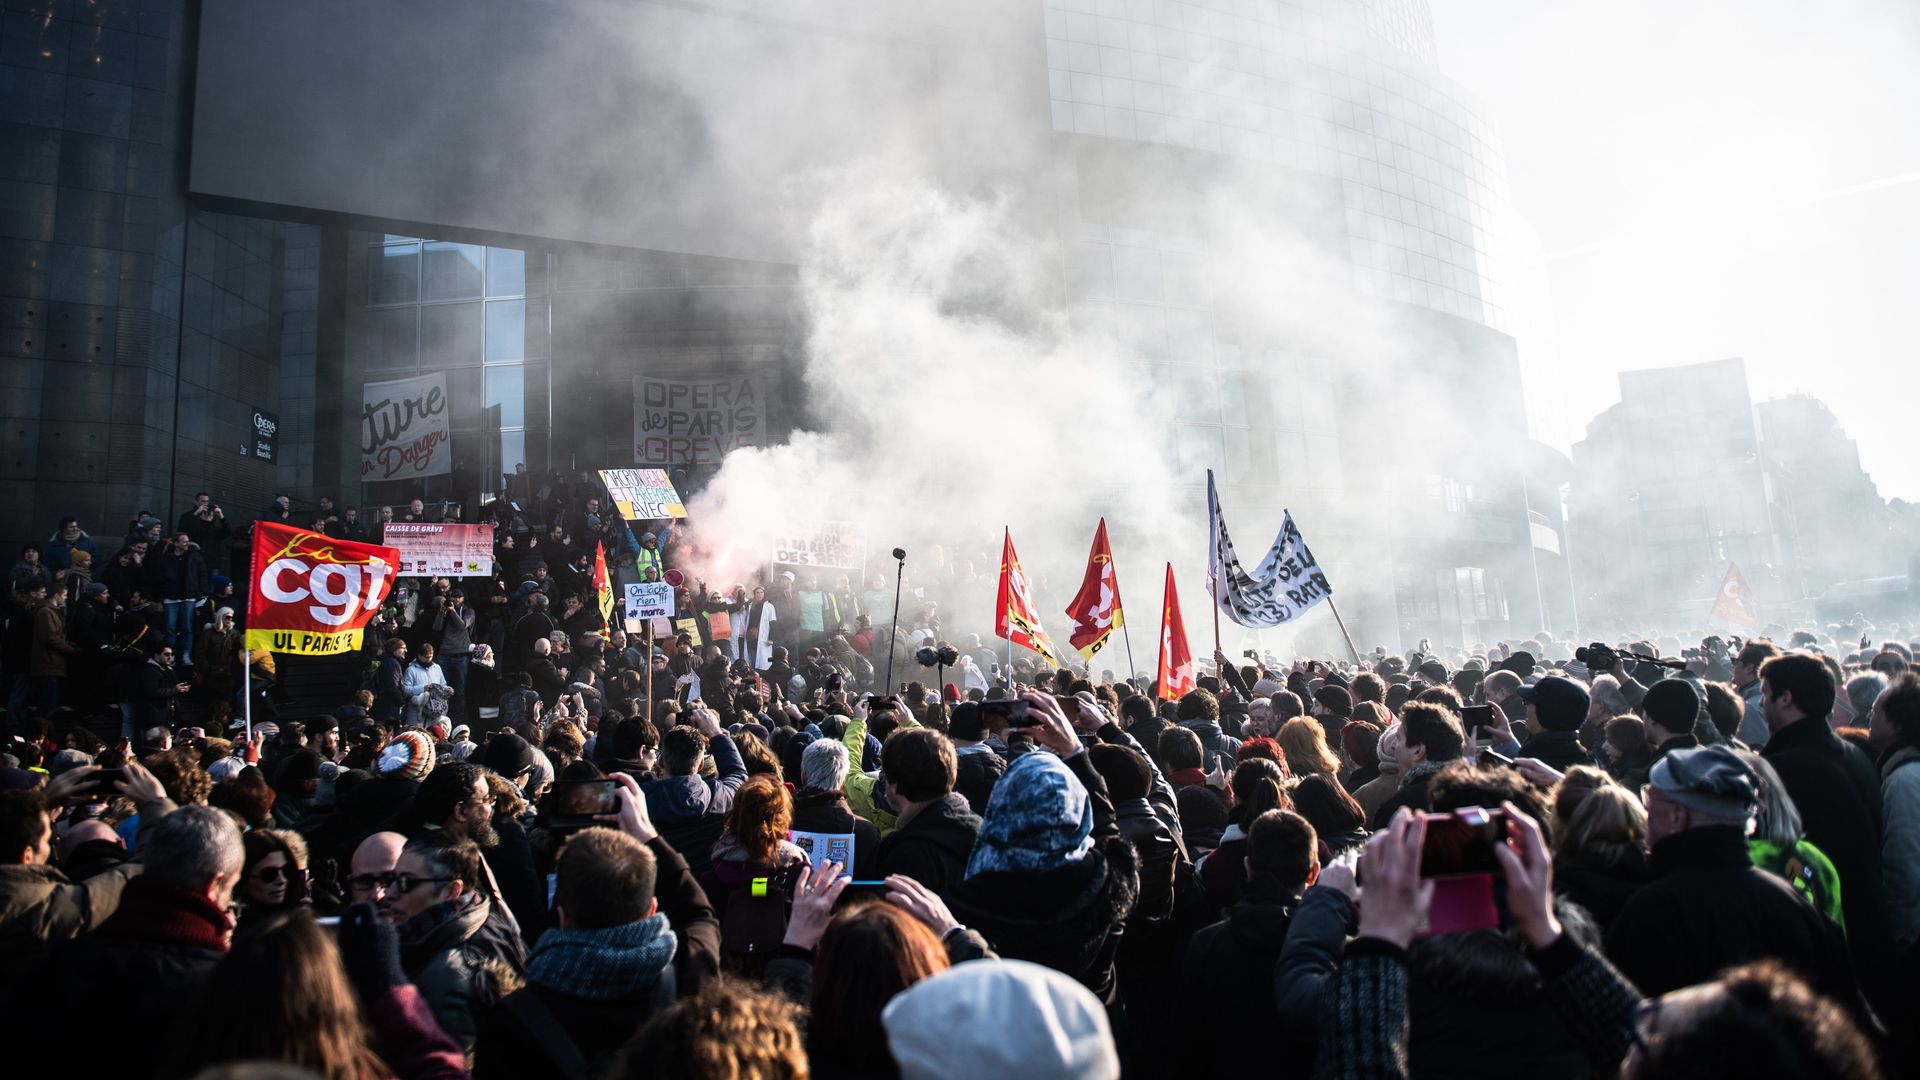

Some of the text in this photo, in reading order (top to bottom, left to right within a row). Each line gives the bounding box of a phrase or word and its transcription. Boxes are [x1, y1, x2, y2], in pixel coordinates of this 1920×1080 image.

[645, 380, 755, 409] OPERA
[641, 406, 757, 436] de PARIS
[377, 430, 449, 479] Danger
[609, 486, 627, 502] ET
[632, 501, 669, 518] AVEC
[777, 550, 809, 565] DES
[260, 555, 393, 626] cgt
[630, 584, 668, 596] On lâche
[1286, 573, 1332, 608] RATP
[636, 596, 656, 605] rien
[274, 632, 297, 650] UL
[301, 635, 341, 652] PARIS
